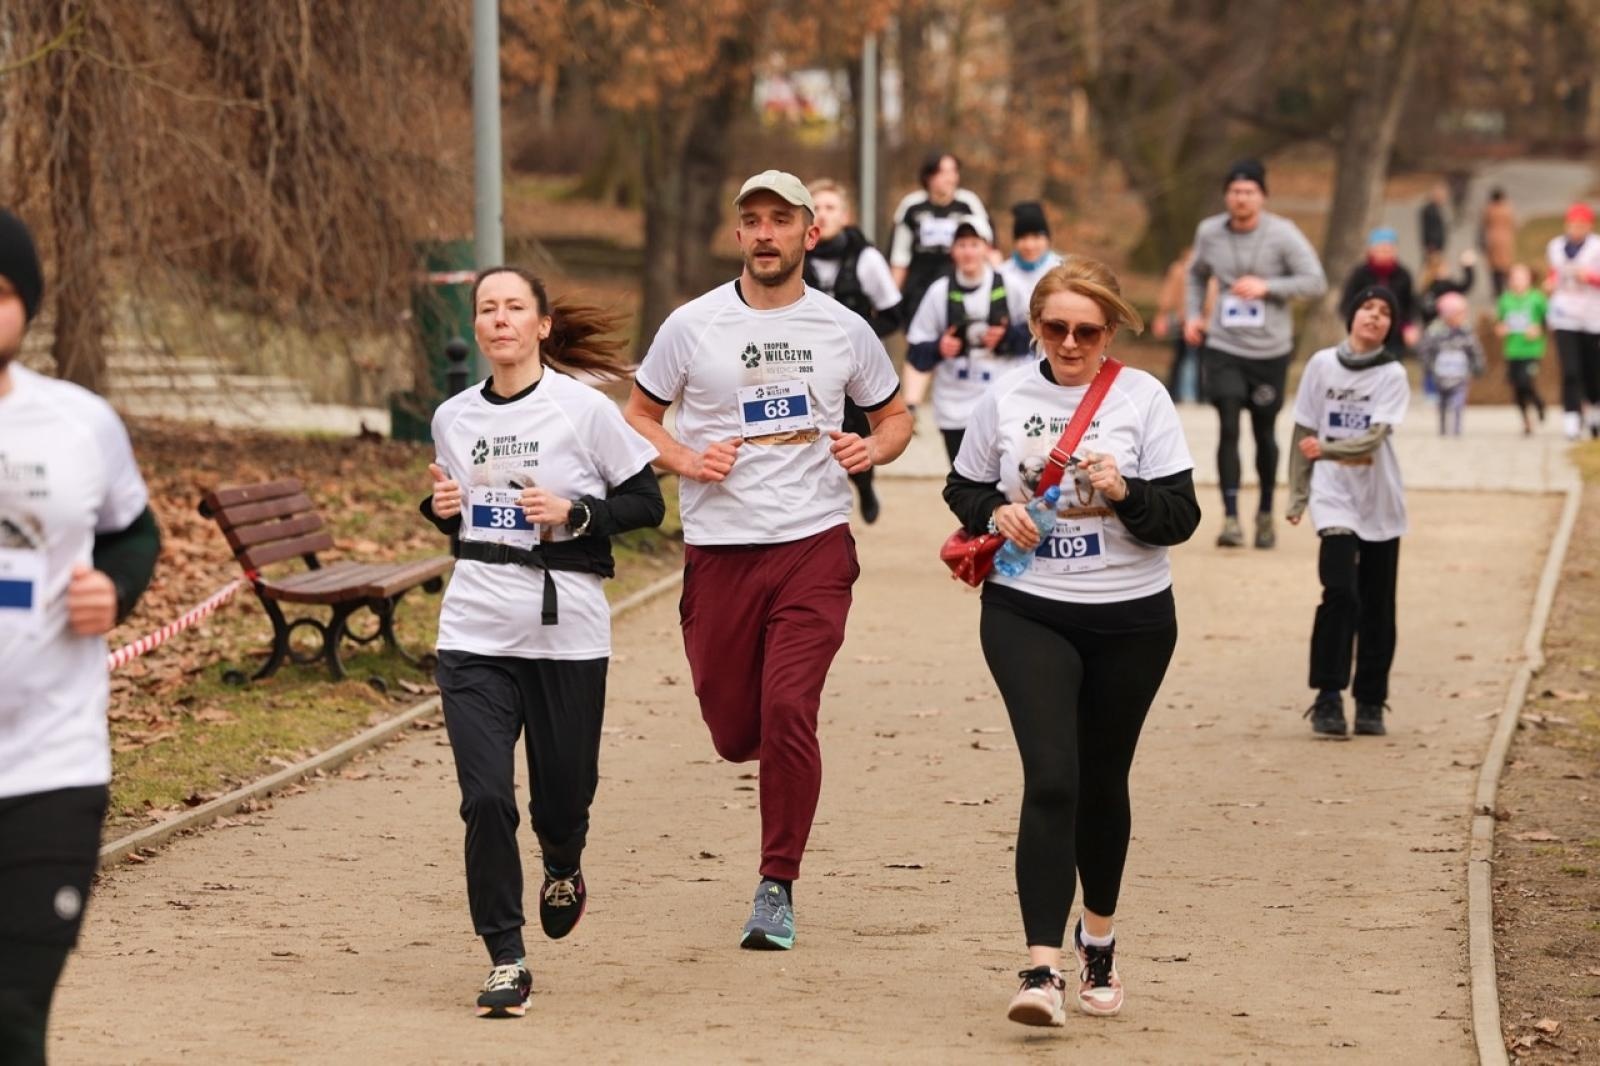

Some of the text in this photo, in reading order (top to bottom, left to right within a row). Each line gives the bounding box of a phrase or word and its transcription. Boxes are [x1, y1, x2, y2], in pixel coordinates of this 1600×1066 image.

[763, 342, 789, 350] TROPEM
[764, 349, 812, 361] WILCZYM
[799, 365, 814, 373] 2026
[766, 387, 790, 396] WILCZYM
[764, 399, 791, 418] 68
[493, 435, 517, 444] TROPEM
[493, 441, 539, 457] WILCZYM
[523, 459, 539, 468] 2026
[490, 507, 516, 528] 38
[1048, 537, 1087, 558] 109
